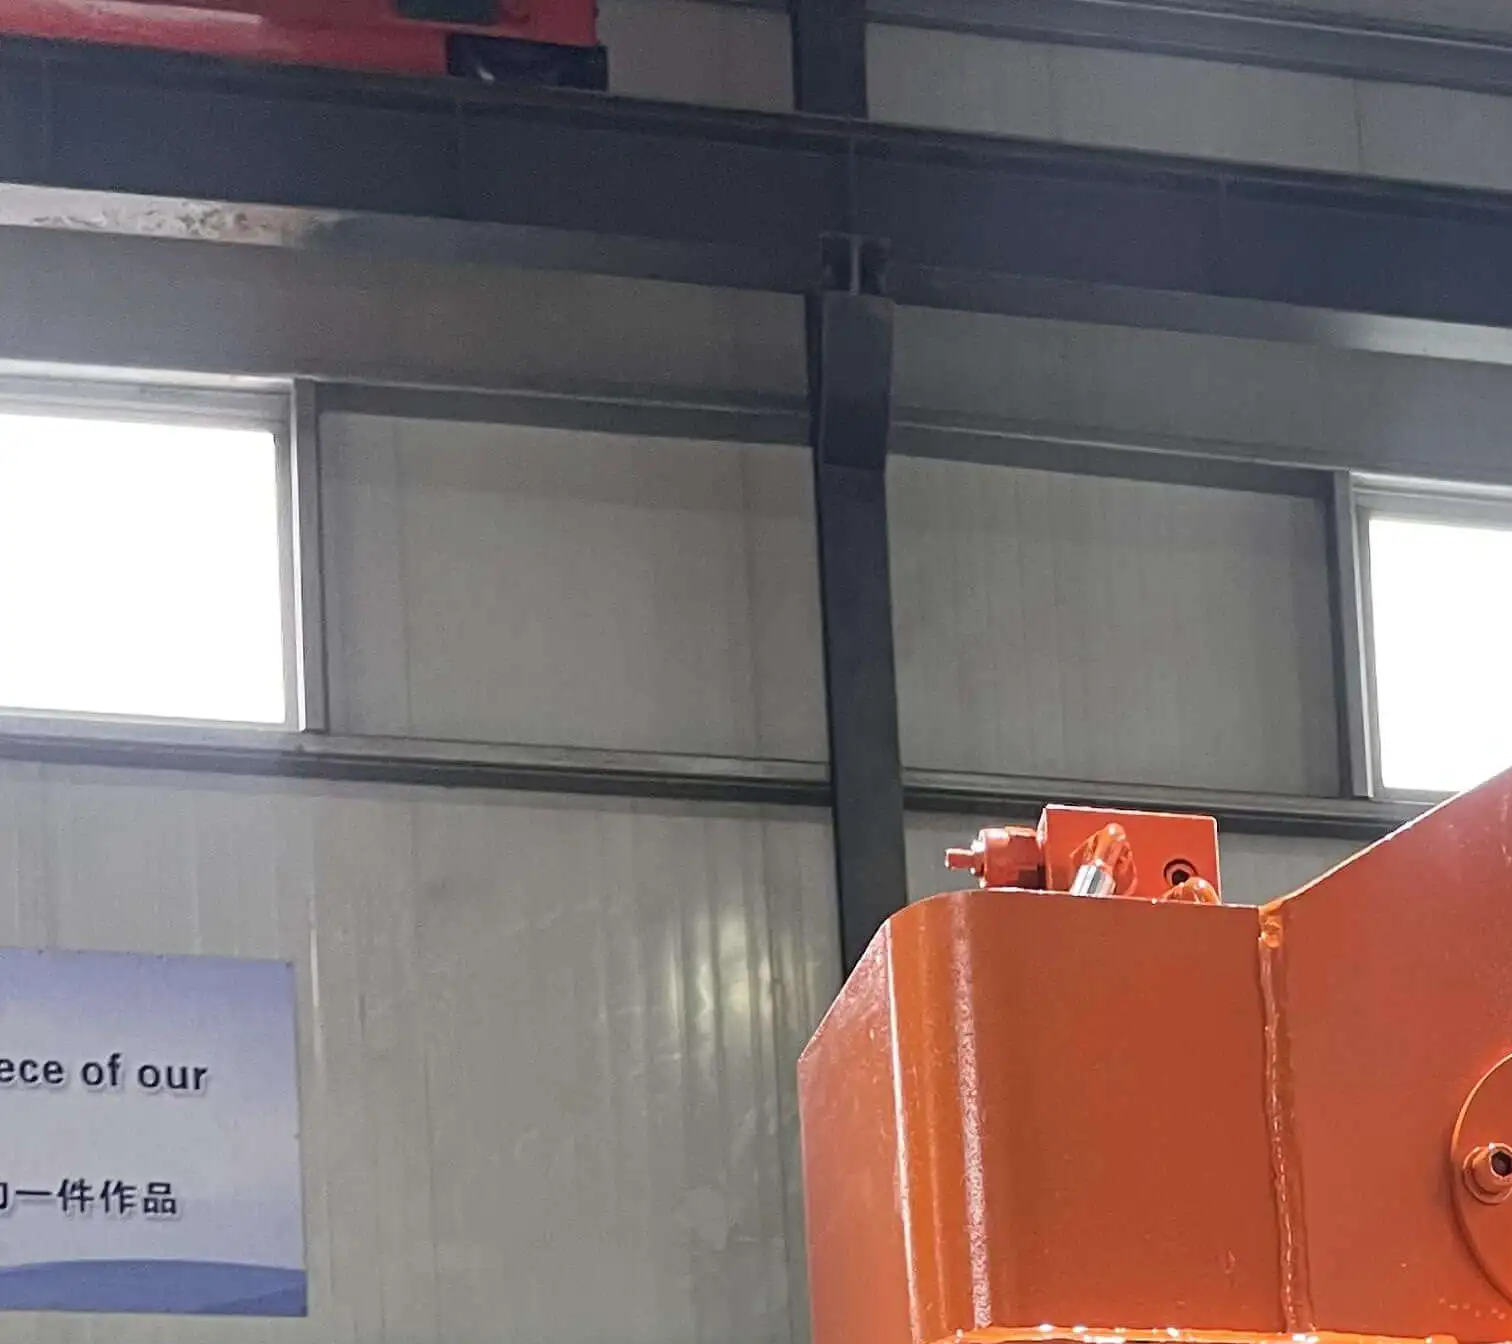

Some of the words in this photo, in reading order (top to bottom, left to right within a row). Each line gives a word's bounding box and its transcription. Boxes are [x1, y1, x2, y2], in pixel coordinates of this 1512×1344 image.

[0, 1059, 64, 1084] ece
[81, 1053, 121, 1086] of
[138, 1064, 208, 1090] our
[0, 1178, 177, 1214] 一件作品
